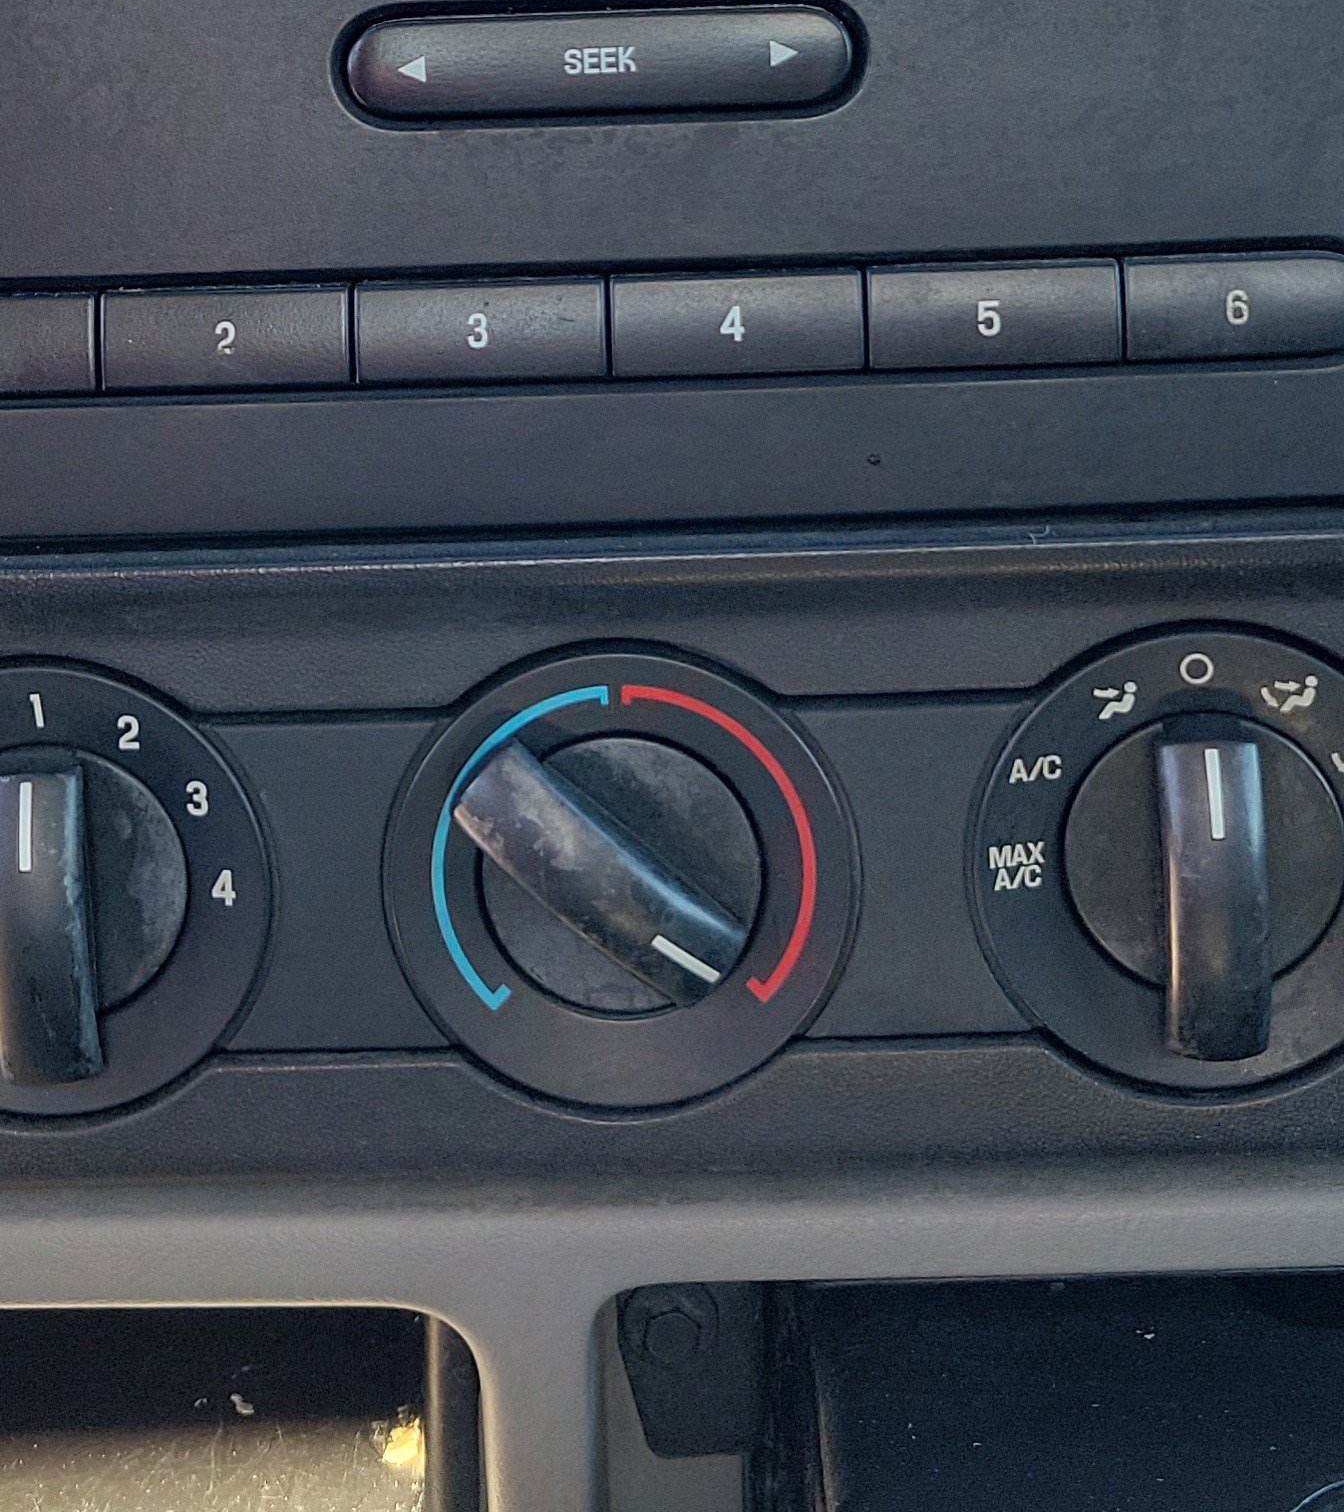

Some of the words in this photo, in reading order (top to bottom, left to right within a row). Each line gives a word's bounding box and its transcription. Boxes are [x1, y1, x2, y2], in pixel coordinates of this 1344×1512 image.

[563, 46, 637, 76] SEEK
[718, 305, 746, 343] 4
[975, 300, 1003, 337] 5
[1225, 289, 1249, 326] 6
[214, 321, 237, 355] 2
[466, 312, 490, 349] 3
[29, 693, 45, 728] 1
[117, 715, 140, 750] 2
[1008, 754, 1063, 785] A/C
[185, 780, 209, 817] 3
[988, 841, 1046, 870] MAX
[211, 869, 237, 907] 4
[993, 864, 1043, 892] A/C
